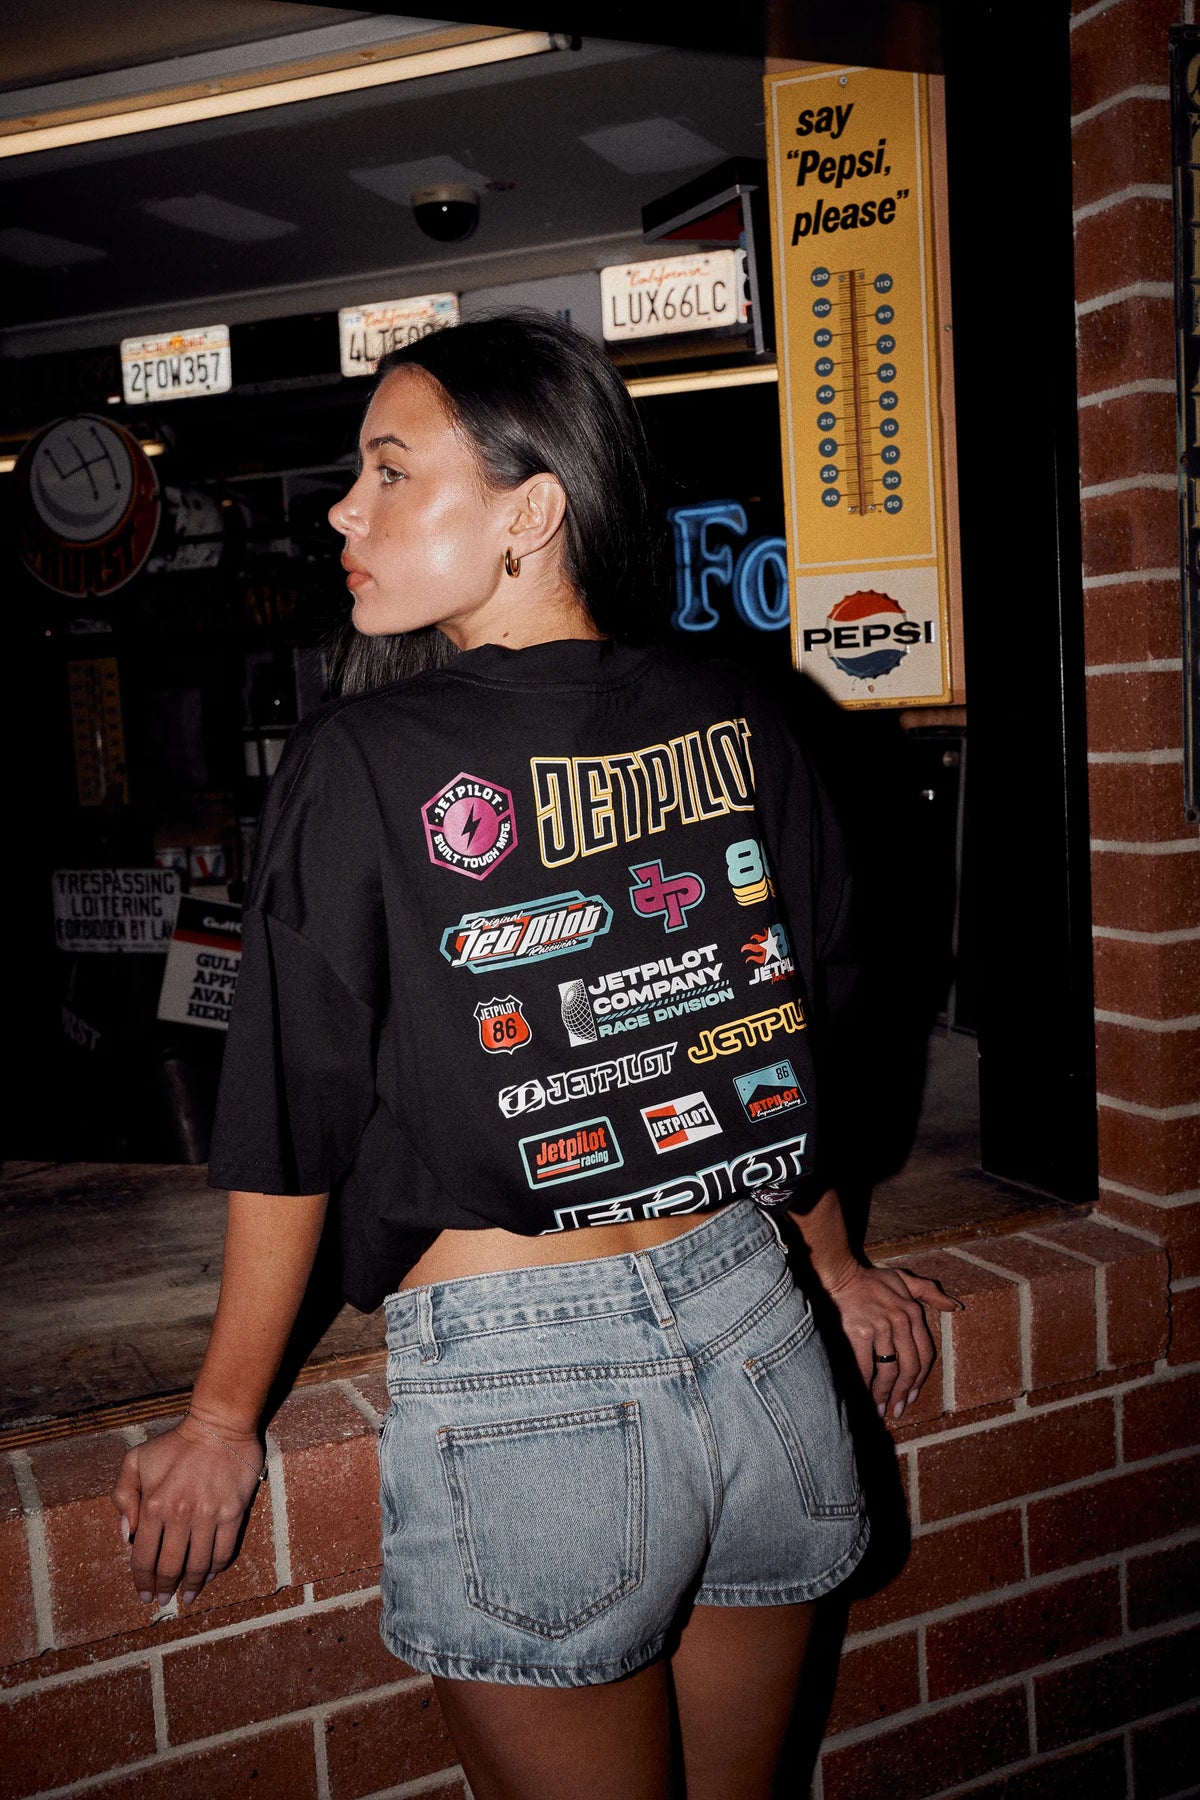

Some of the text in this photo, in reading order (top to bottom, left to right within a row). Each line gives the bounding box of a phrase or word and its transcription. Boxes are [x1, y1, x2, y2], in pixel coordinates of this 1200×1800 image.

[796, 103, 854, 139] say
[787, 138, 891, 189] “Pepsi,
[791, 188, 910, 246] please”
[612, 281, 726, 326] LUX66LC
[803, 620, 934, 652] PEPSI
[434, 784, 503, 818] JETPILOT
[433, 833, 461, 864] BUILT
[462, 847, 500, 869] TOUGH
[56, 872, 175, 895] TRESPASSING
[71, 896, 163, 917] LOITERING
[470, 910, 524, 930] Original
[56, 918, 127, 941] FORBIDDEN
[130, 918, 147, 941] BY
[588, 943, 718, 995] JETPILOT
[593, 962, 723, 1015] COMPANY
[480, 1001, 516, 1021] JETPILOT
[598, 987, 735, 1038] RACE DIVISION
[493, 1017, 517, 1043] 86
[546, 1041, 678, 1105] JETPILOT
[775, 1065, 789, 1080] 86
[748, 1087, 799, 1118] JETPILOT
[651, 1107, 710, 1138] JETPILOT
[536, 1127, 607, 1166] Jetpilot
[580, 1150, 609, 1167] racing
